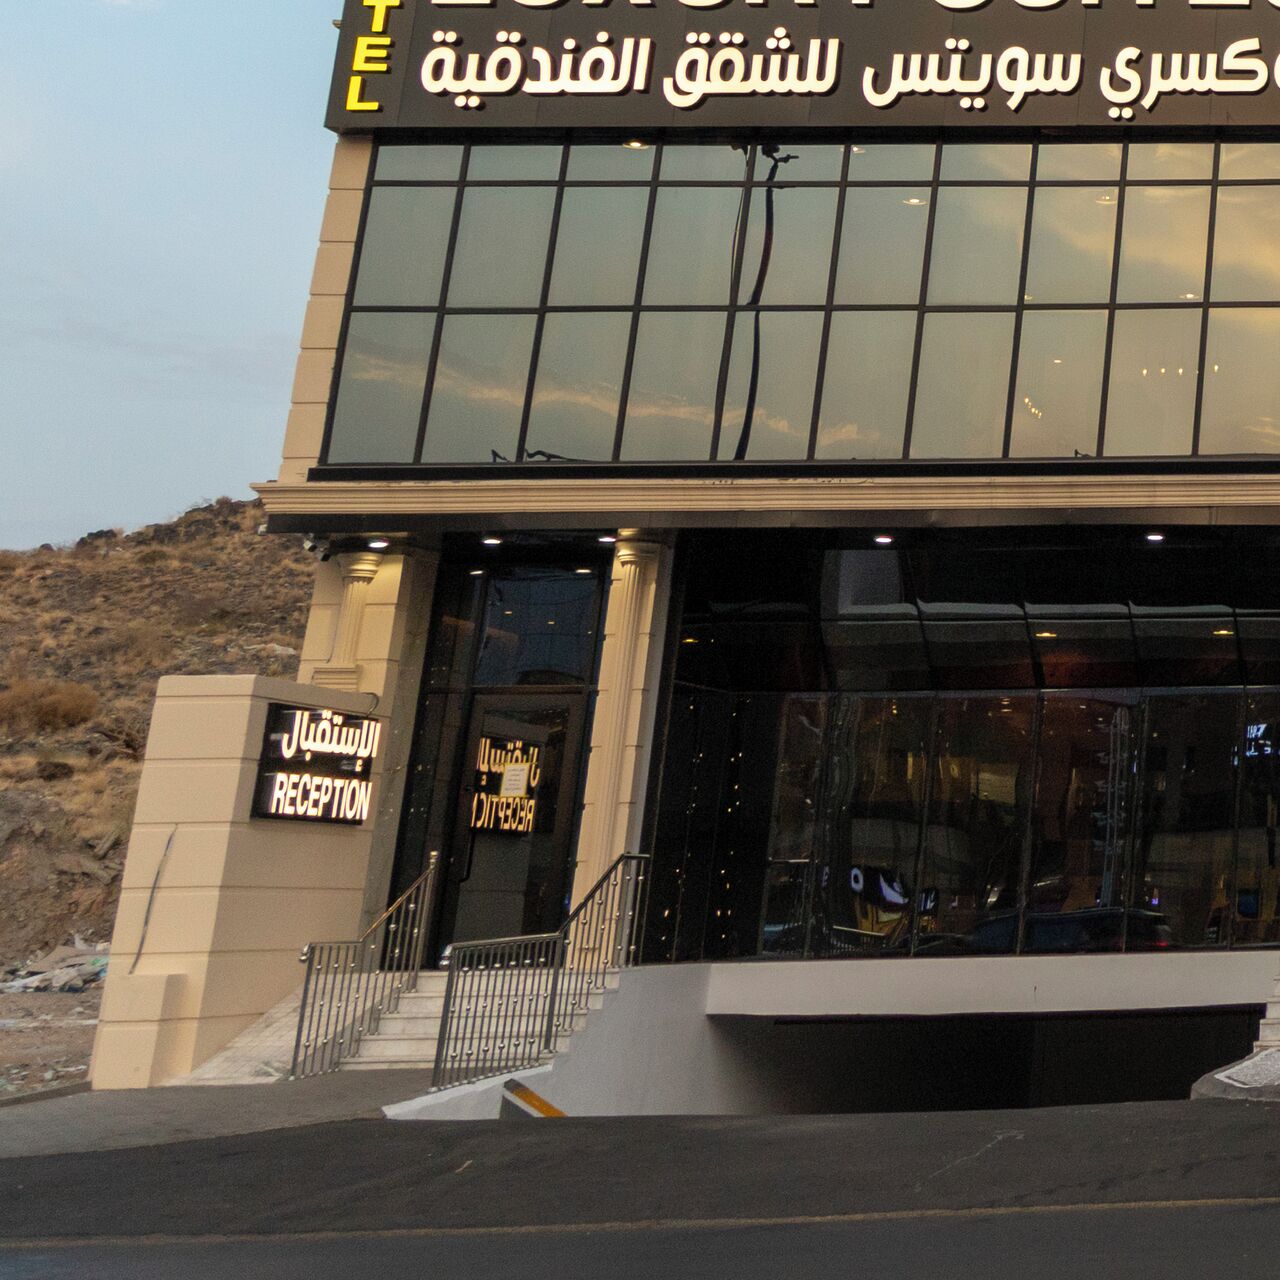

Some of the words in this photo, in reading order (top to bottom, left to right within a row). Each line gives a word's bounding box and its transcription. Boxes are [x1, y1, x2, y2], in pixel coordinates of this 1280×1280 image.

[420, 30, 651, 109] الفندقية
[662, 26, 839, 109] للشقق
[862, 37, 1082, 110] سويتس
[281, 709, 382, 772] الإستقبال
[270, 773, 373, 821] RECEPTION
